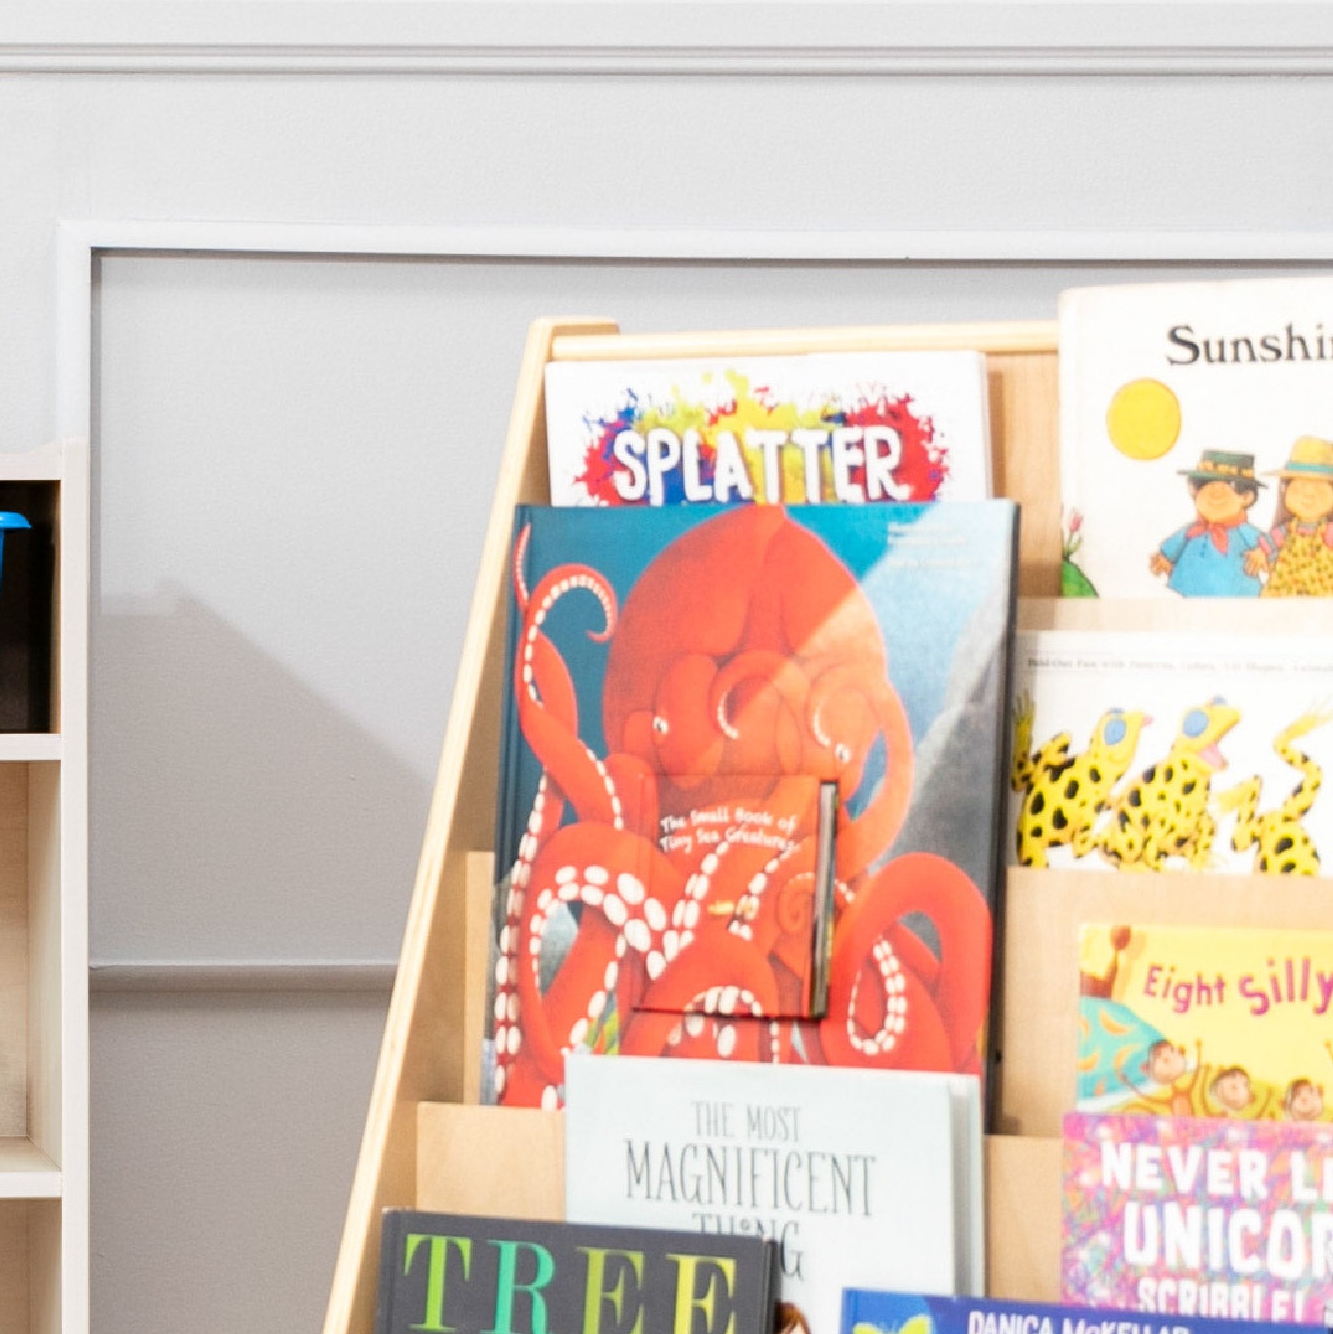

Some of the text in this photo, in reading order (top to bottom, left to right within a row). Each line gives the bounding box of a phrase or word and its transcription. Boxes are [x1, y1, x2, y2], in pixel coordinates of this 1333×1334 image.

[1166, 320, 1333, 365] Sunshi
[611, 425, 911, 507] SPLATTER
[659, 823, 800, 853] Tiny Sea Creatures
[660, 807, 797, 835] The Small Book of
[1143, 955, 1333, 1017] Eight Silly
[691, 1099, 803, 1143] THE MOST
[623, 1137, 877, 1217] MAGNIFICENT
[1100, 1140, 1268, 1201] NEVER
[1124, 1200, 1333, 1281] UNICOR
